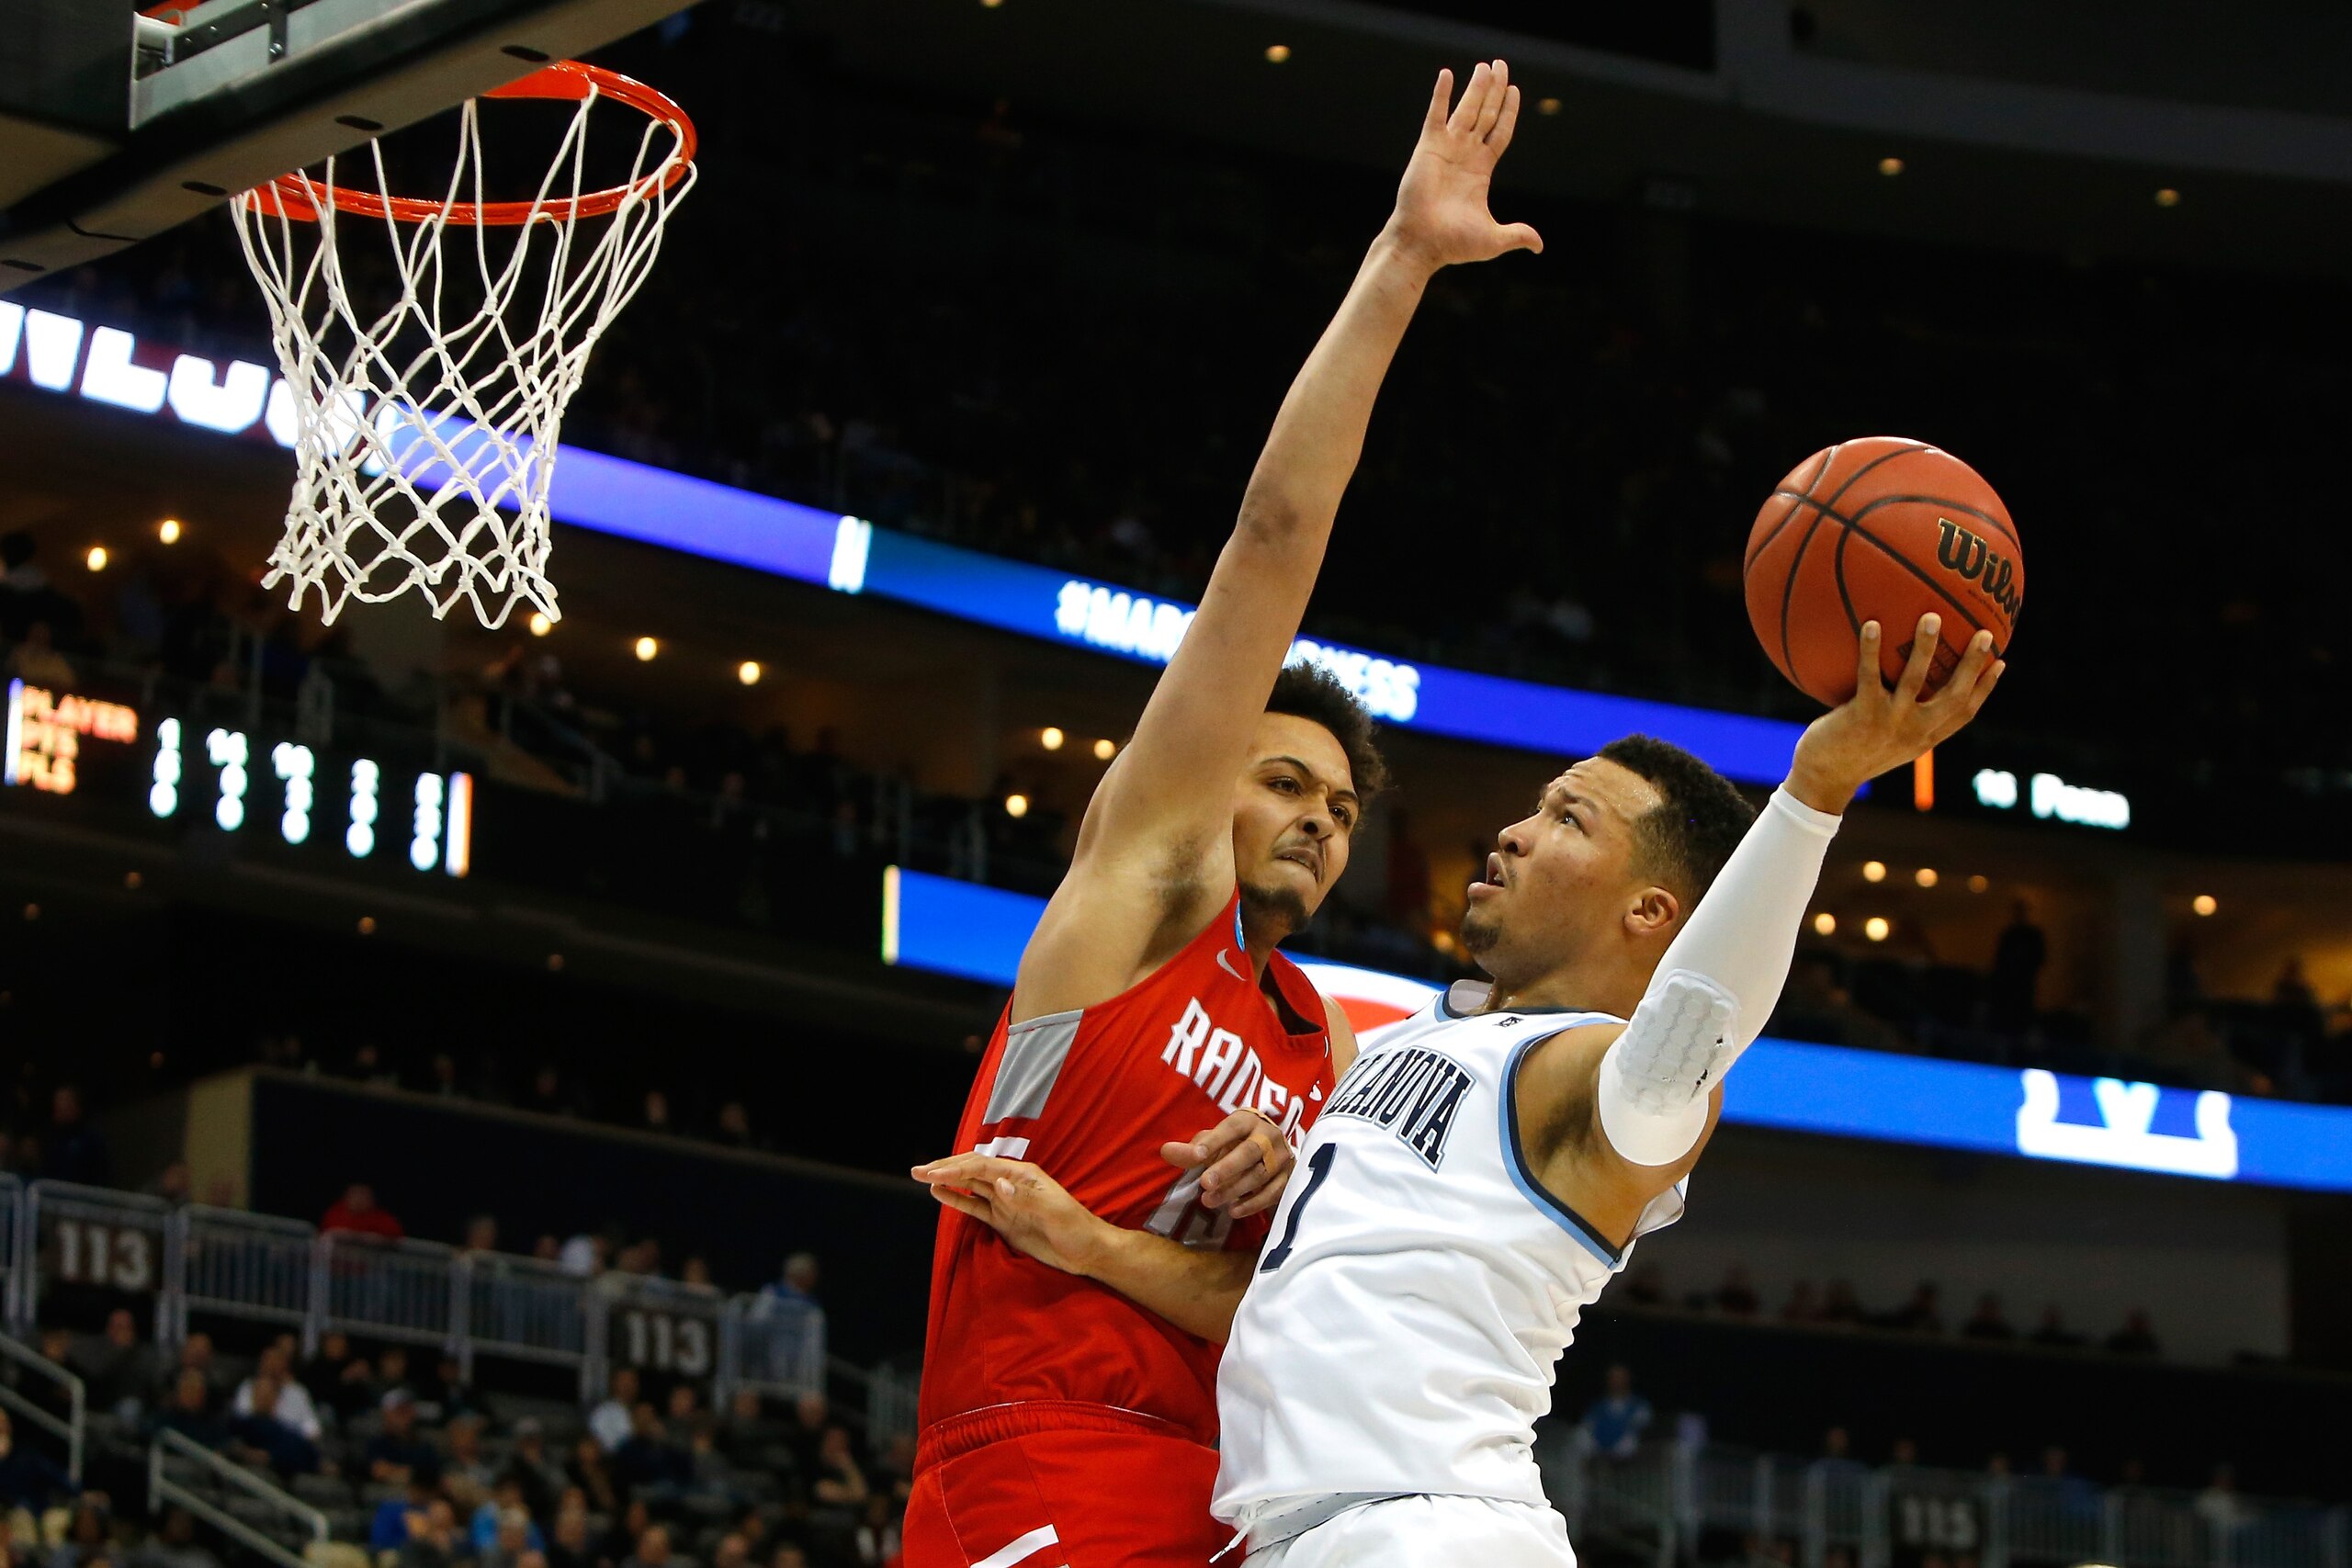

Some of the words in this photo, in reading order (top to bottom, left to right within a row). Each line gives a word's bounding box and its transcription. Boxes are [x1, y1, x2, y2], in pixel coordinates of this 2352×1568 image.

[1160, 996, 1307, 1160] RADFO
[58, 1221, 149, 1291] 113
[1260, 1142, 1337, 1274] 1
[627, 1312, 707, 1376] 113
